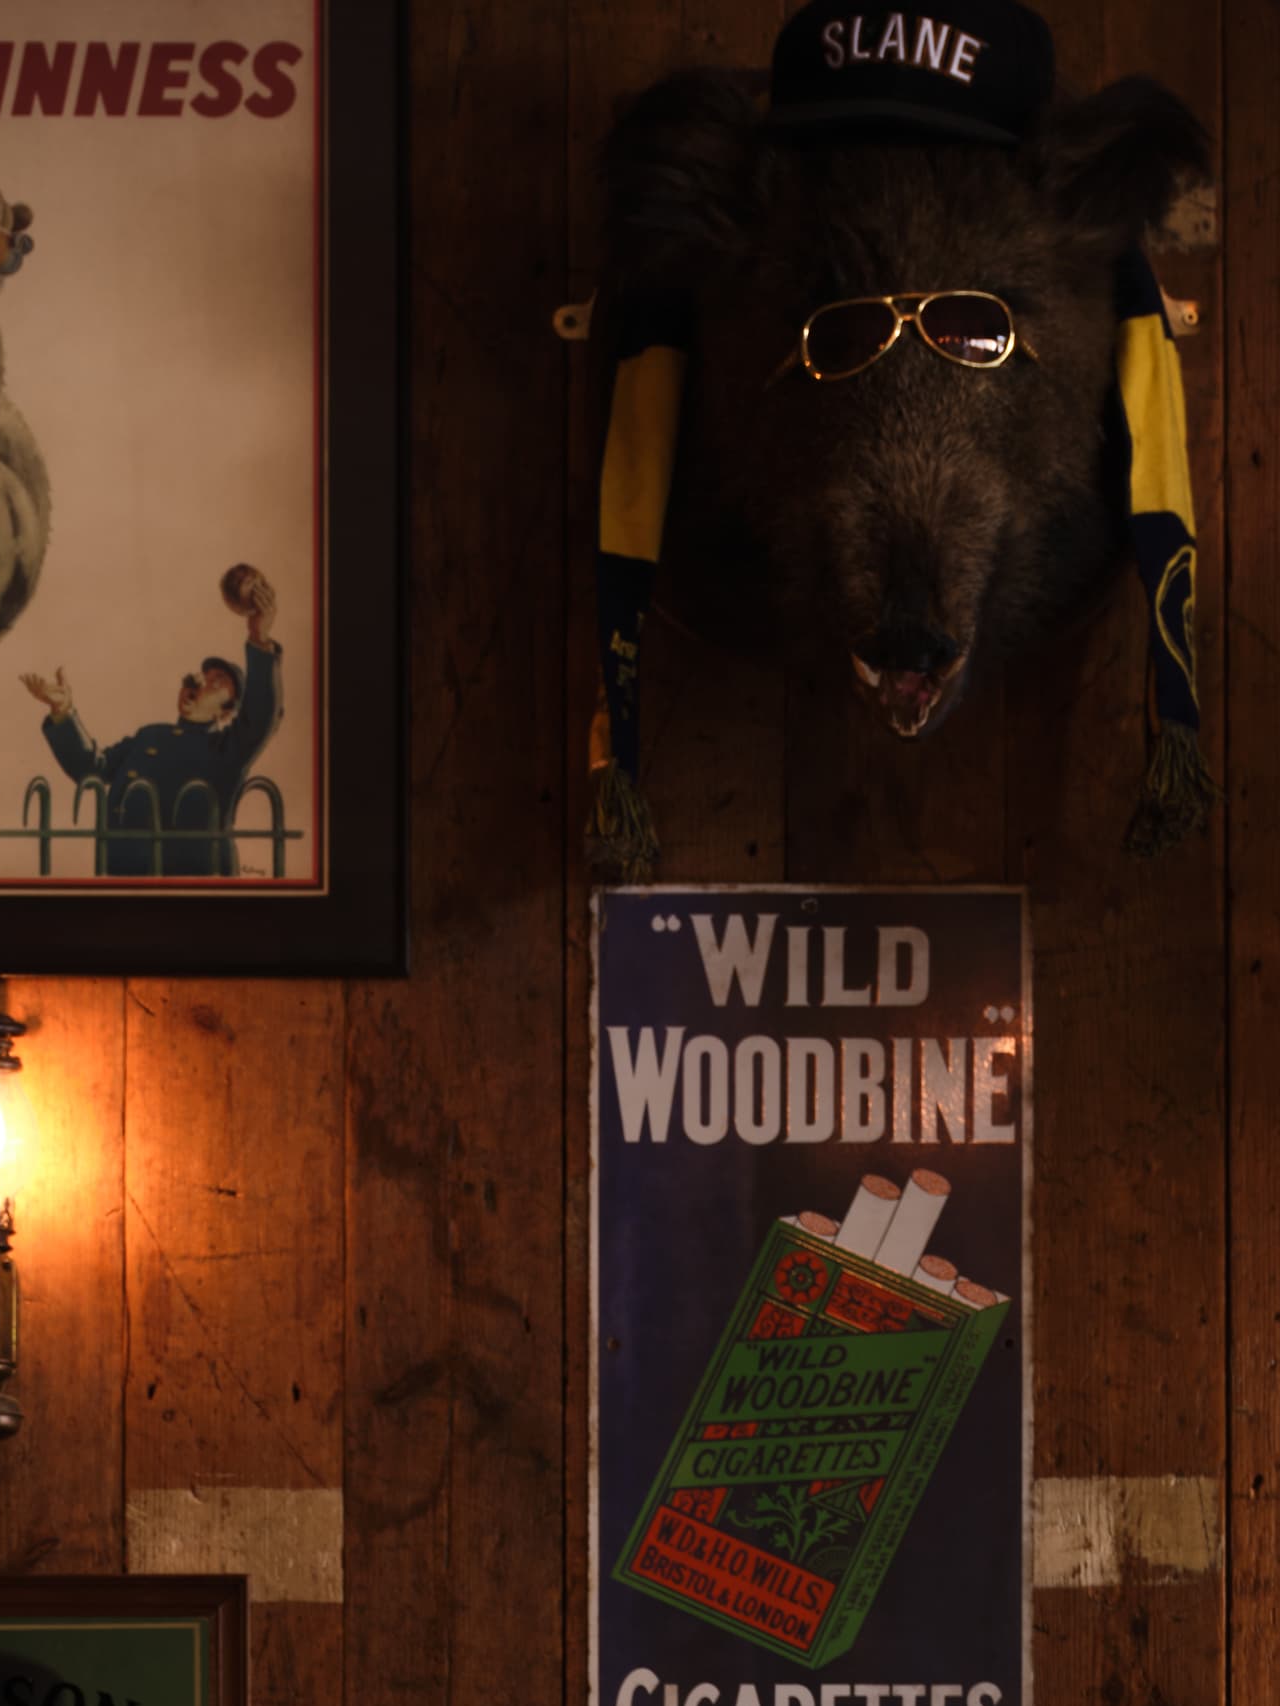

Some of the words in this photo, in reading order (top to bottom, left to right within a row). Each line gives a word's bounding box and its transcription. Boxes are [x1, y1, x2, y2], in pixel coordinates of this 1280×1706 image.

[820, 12, 982, 84] SLANE
[692, 1439, 886, 1480] CIGARETTES
[640, 1546, 719, 1601] BRISTOL
